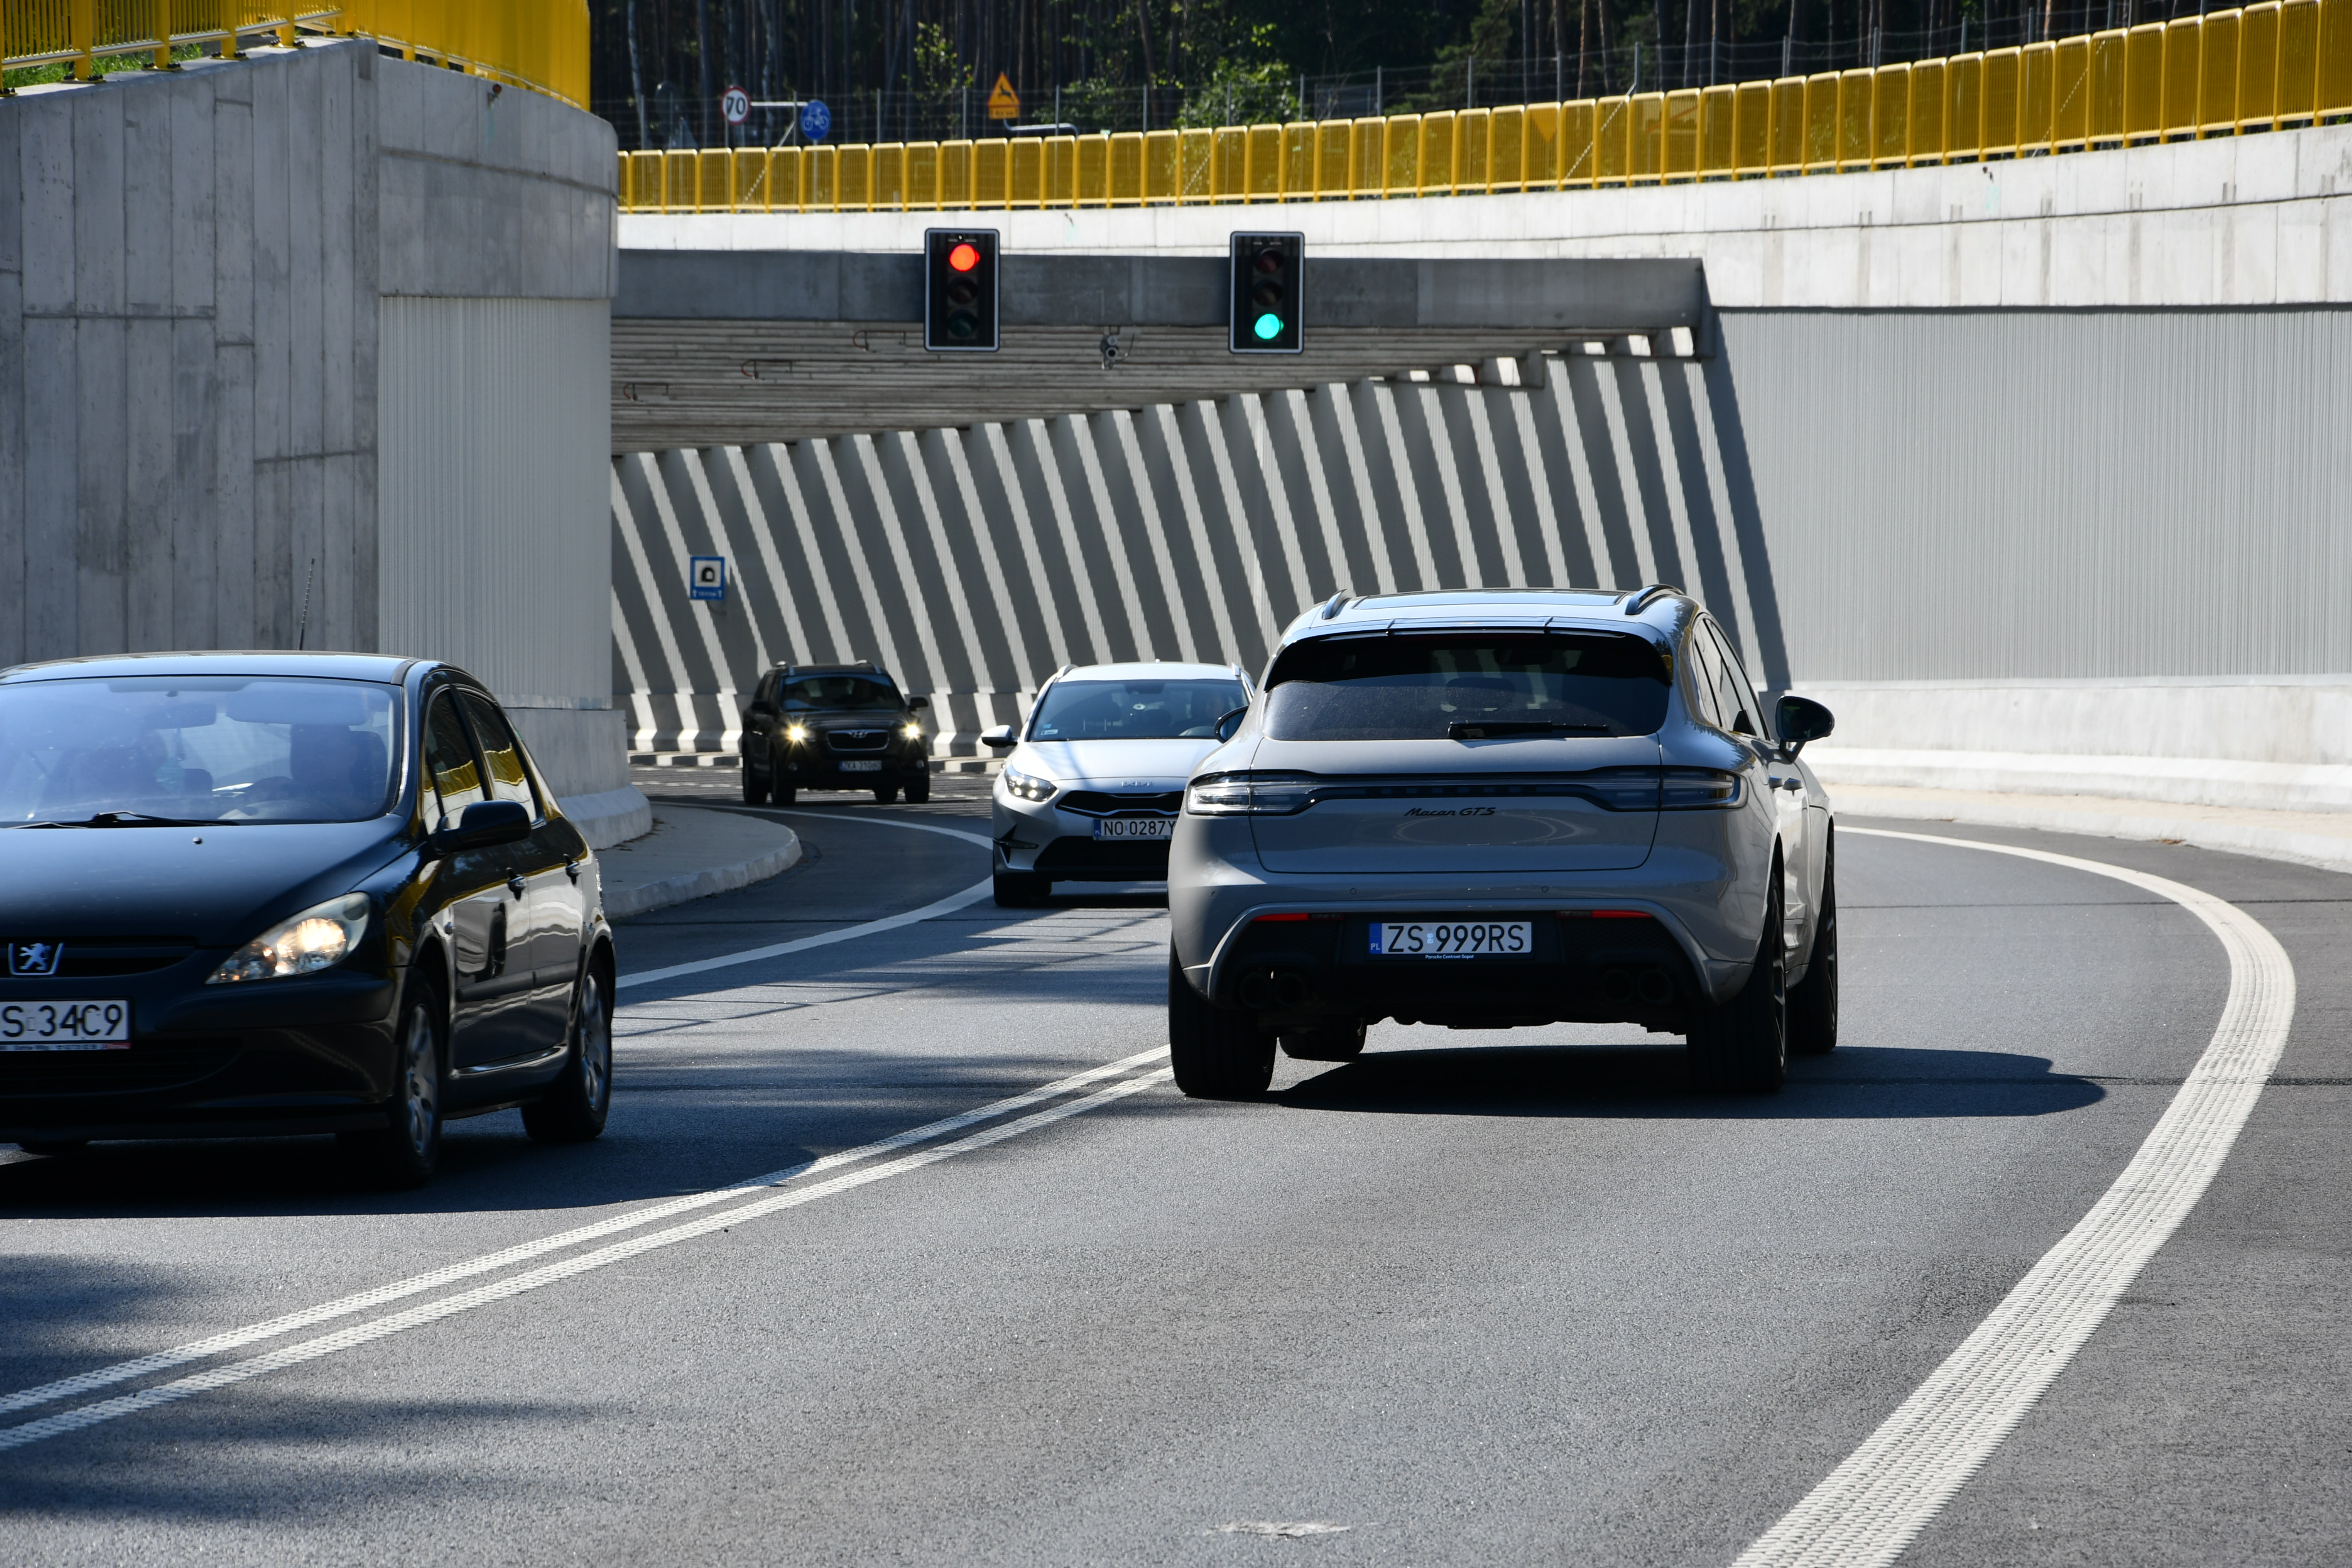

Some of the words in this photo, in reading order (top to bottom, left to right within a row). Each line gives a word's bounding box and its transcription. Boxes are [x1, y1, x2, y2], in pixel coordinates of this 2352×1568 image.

[726, 96, 746, 115] 70
[1404, 808, 1455, 817] Macan
[1459, 807, 1496, 816] GTS
[1104, 821, 1124, 835] NO
[1129, 821, 1177, 835] 0287Y
[1388, 925, 1423, 952] ZS
[1436, 925, 1524, 952] 999RS
[38, 1004, 122, 1036] 34C9
